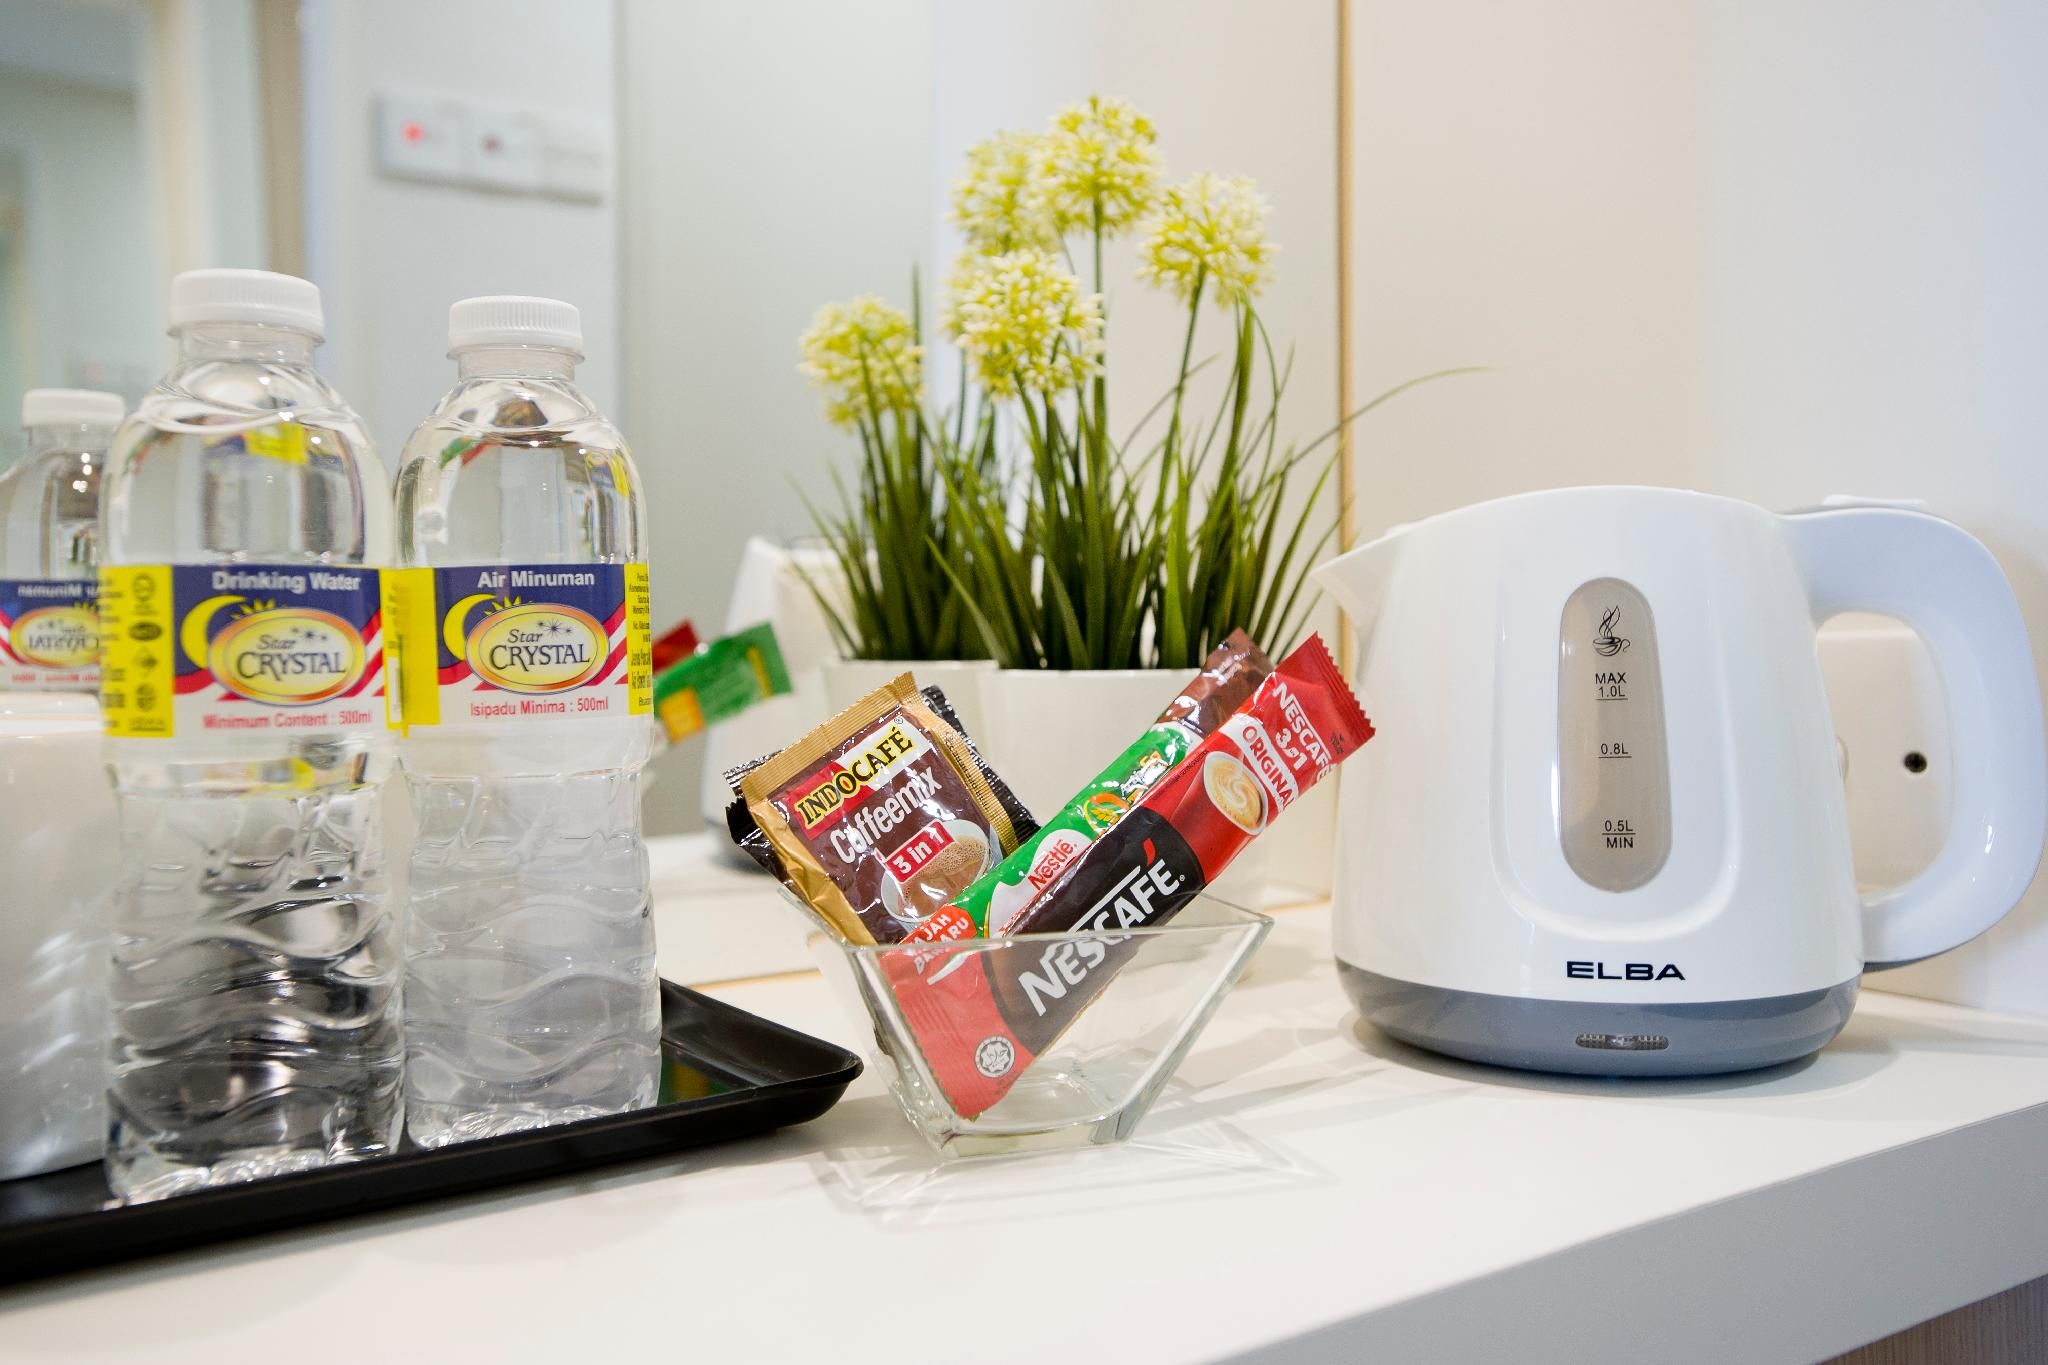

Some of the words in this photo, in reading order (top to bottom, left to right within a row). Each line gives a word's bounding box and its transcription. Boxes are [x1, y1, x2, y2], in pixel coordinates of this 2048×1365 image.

[212, 571, 306, 594] Drinking
[309, 572, 361, 590] Water
[477, 571, 508, 588] Air
[511, 570, 595, 587] Minuman
[257, 634, 297, 650] Star
[507, 629, 543, 643] Star
[237, 651, 346, 681] CRYSTAL
[489, 644, 590, 672] CRYSTAL
[1595, 672, 1627, 685] MAX
[1598, 685, 1626, 698] 1.0L
[470, 702, 516, 719] Isipadu
[520, 699, 565, 715] Minima
[577, 696, 609, 712] 500ml
[203, 714, 269, 729] Minimum
[275, 711, 328, 727] Content
[338, 709, 371, 724] 500ml
[1600, 743, 1629, 755] 0.8L
[795, 727, 913, 824] INDOCAFÉ
[829, 766, 943, 864] Coffeemix
[1604, 820, 1634, 832] 0.5L
[1606, 837, 1634, 849] MIN
[891, 855, 911, 874] 3
[1566, 960, 1687, 982] ELBA
